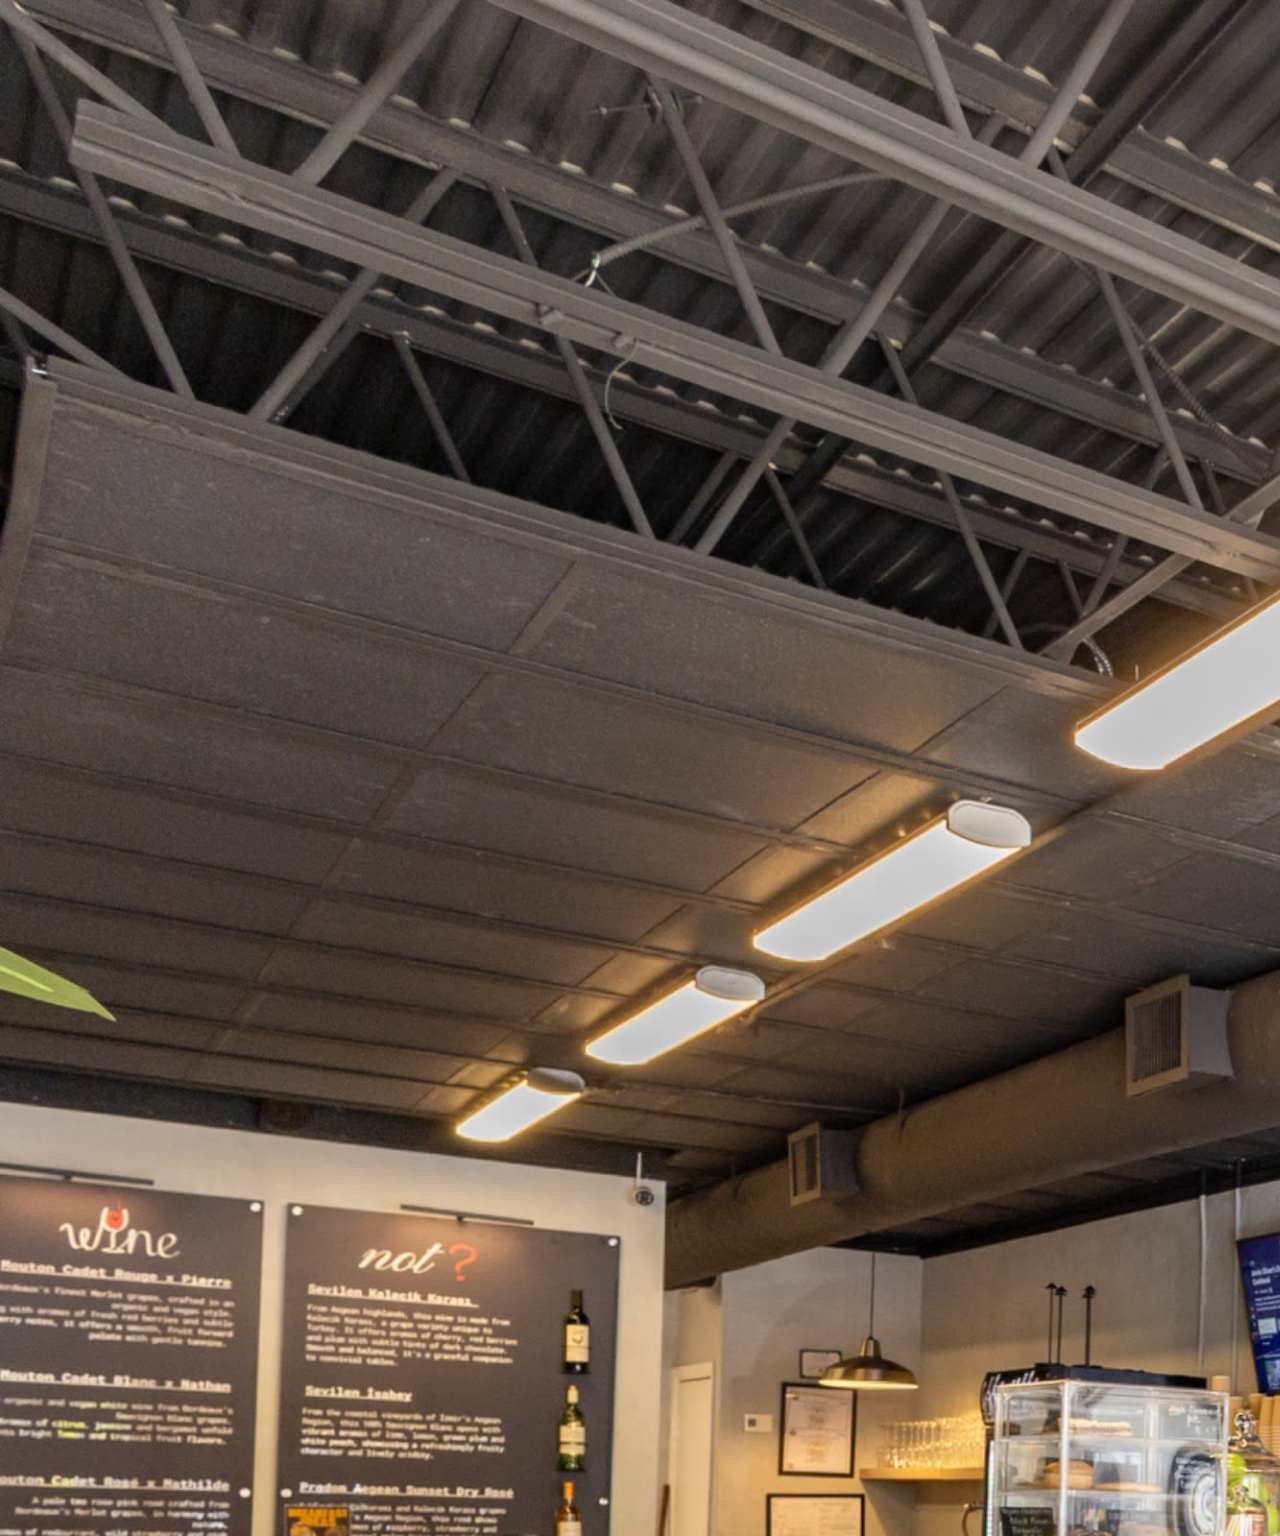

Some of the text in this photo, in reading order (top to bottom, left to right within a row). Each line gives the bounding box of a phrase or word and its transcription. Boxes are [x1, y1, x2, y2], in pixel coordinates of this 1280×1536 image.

[59, 1206, 181, 1258] wine
[1, 1259, 55, 1275] Mouton
[63, 1263, 107, 1279] Cadet
[115, 1267, 158, 1283] Rouge
[182, 1273, 232, 1289] Pierre
[308, 1283, 362, 1298] Sevilen
[369, 1288, 420, 1304] Kalecik
[1, 1368, 55, 1384] Mouton
[61, 1371, 105, 1387] Cadet
[113, 1374, 157, 1389] Blanc
[180, 1379, 231, 1393] Nathan
[305, 1385, 360, 1400] Sevilen
[0, 1475, 45, 1488] outon
[51, 1475, 96, 1489] Cadet
[163, 1478, 230, 1492] Mathilde
[353, 1482, 399, 1497] Aegean
[406, 1484, 449, 1498] Sunset
[456, 1486, 479, 1499] Dry
